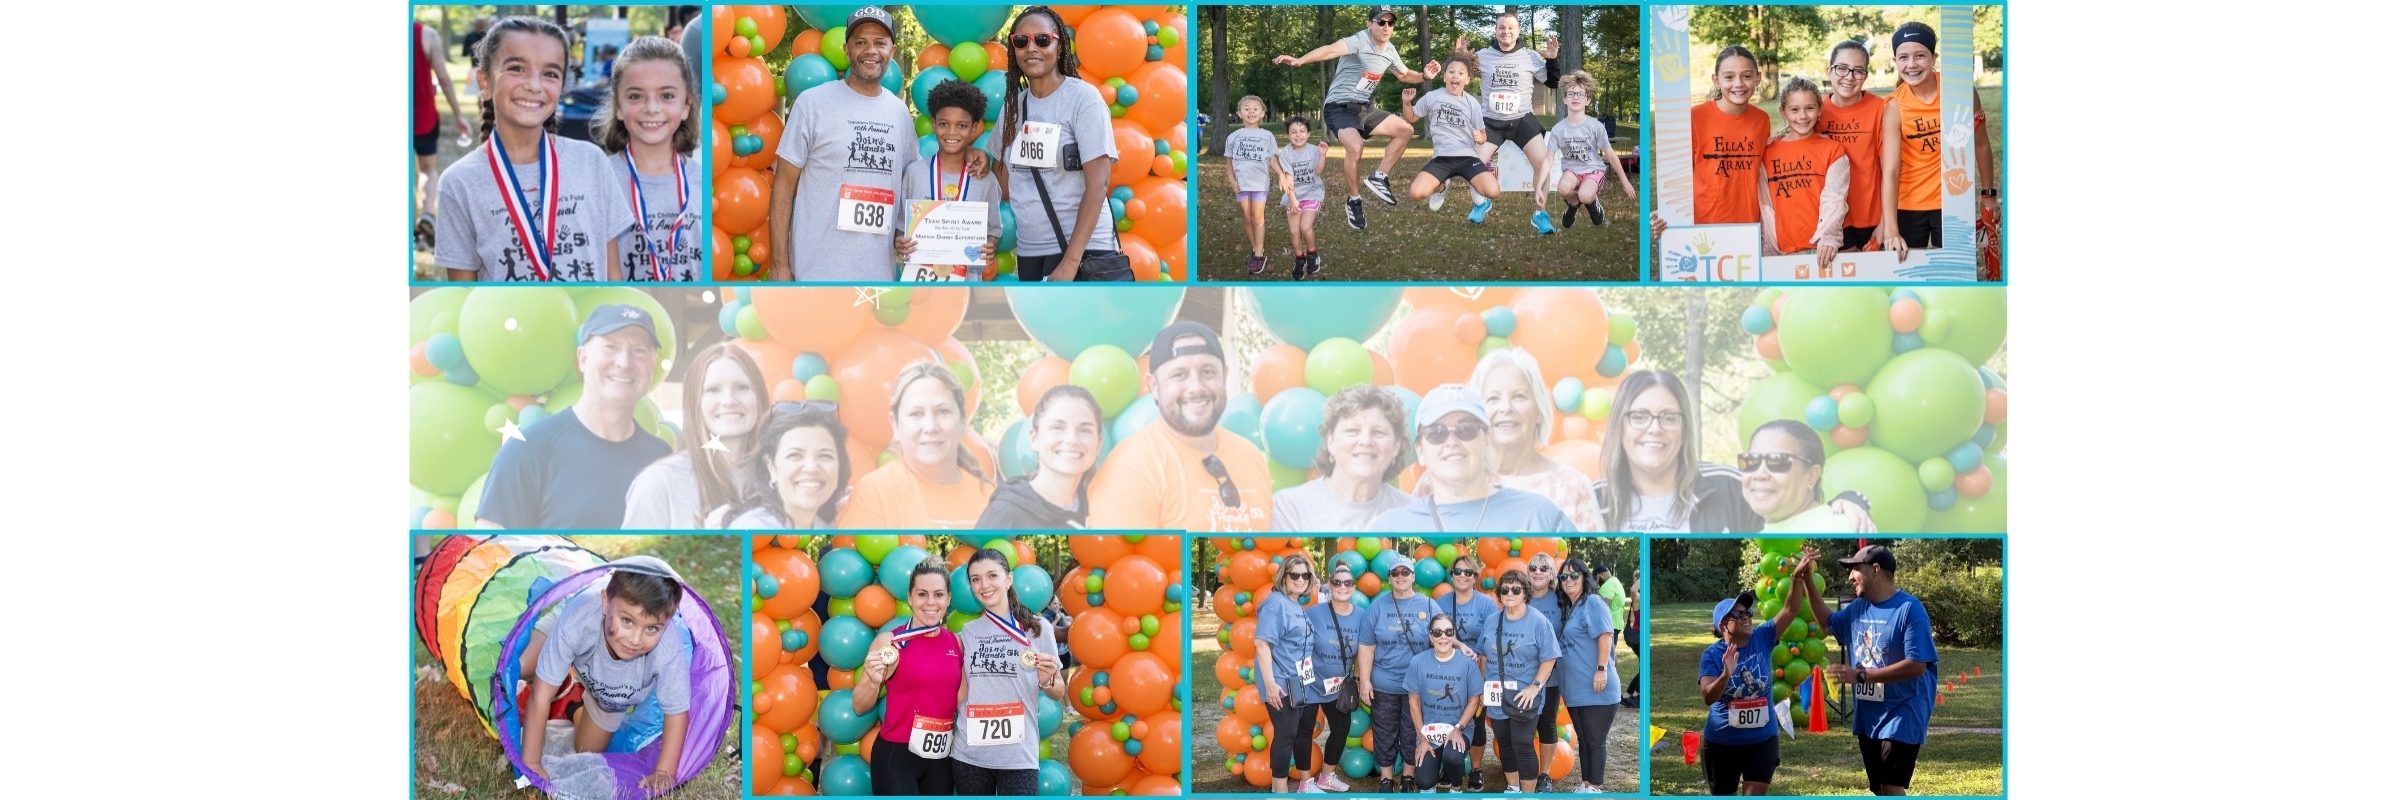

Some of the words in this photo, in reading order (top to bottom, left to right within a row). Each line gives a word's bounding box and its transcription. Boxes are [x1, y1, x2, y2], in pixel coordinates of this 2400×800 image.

[854, 6, 886, 18] GOD
[1495, 101, 1514, 112] 8112
[1826, 118, 1860, 131] ELLA'S
[1913, 117, 1941, 132] ELL
[858, 143, 885, 153] Hands
[1020, 140, 1044, 160] 8166
[1713, 135, 1754, 153] ELLA'S
[1714, 160, 1753, 178] ARMY
[1771, 155, 1812, 175] ELLA'S
[1776, 179, 1812, 198] ARMY
[853, 202, 885, 228] 638
[1698, 254, 1752, 282] TCF
[1006, 649, 1020, 657] 5k
[1856, 682, 1875, 697] 609
[1738, 708, 1761, 725] 607
[979, 718, 1012, 740] 720
[922, 732, 948, 754] 699
